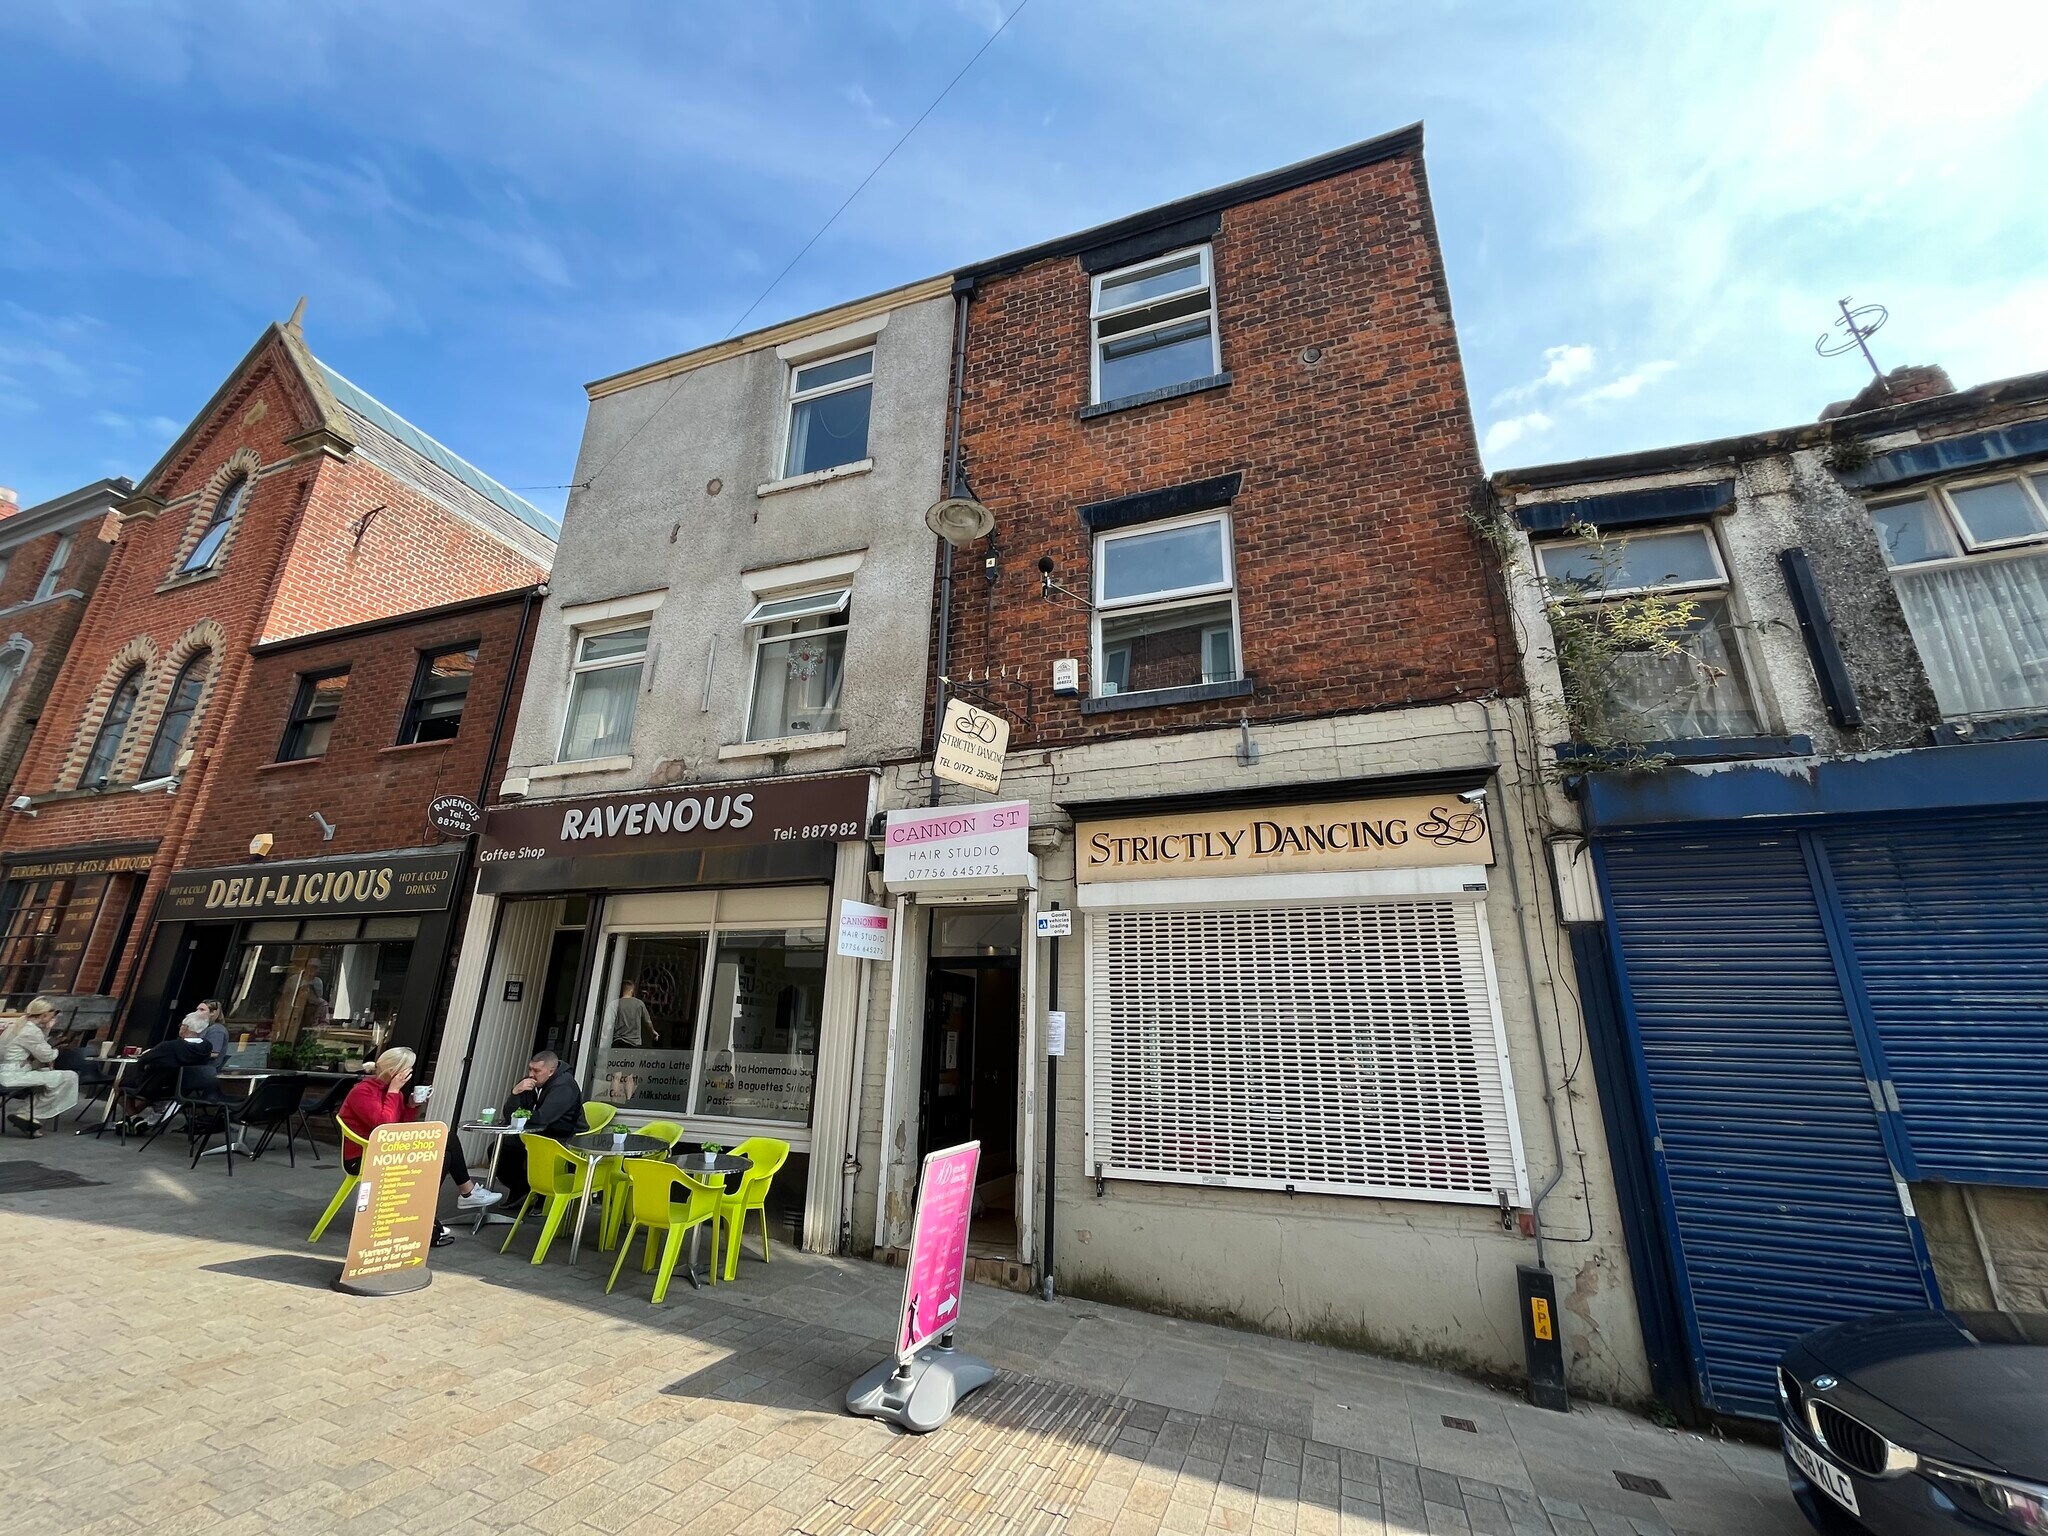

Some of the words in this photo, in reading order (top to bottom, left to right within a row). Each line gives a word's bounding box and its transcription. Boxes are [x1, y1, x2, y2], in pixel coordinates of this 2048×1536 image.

[940, 732, 976, 754] STRICTLY
[976, 745, 1005, 764] DANCING
[433, 798, 480, 821] RAVENOUS
[449, 809, 464, 819] Tel:
[560, 793, 755, 841] RAVENOUS
[437, 816, 471, 830] 887982
[892, 818, 976, 843] CANNON
[992, 810, 1020, 828] ST
[773, 826, 797, 841] Tel:
[801, 822, 858, 839] 887982
[1089, 829, 1246, 866] STRICTLY
[1252, 820, 1408, 858] DANCING
[480, 847, 516, 863] Coffee
[518, 845, 546, 860] Shop
[908, 849, 941, 861] HAIR
[947, 845, 1000, 859] STUDIO
[10, 864, 53, 878] EUROPEAN
[53, 862, 76, 875] FINE
[75, 860, 98, 873] ARTS
[98, 861, 106, 872] &
[106, 856, 153, 871] ANTIQUES
[908, 867, 946, 880] 07756
[952, 864, 999, 877] 645275
[399, 872, 418, 882] HOT
[417, 872, 424, 882] &
[424, 870, 449, 881] COLD
[205, 868, 393, 909] DELI-LICIOUS
[405, 884, 437, 895] DRINKS
[175, 897, 195, 906] FOOD
[841, 916, 873, 927] CANNON
[841, 930, 859, 939] HAIR
[860, 932, 885, 943] STUDIO
[840, 942, 860, 951] 07756
[862, 946, 884, 955] 645275
[638, 1060, 666, 1069] Mocha
[669, 1060, 691, 1070] Latte
[738, 1080, 784, 1093] Baguettes
[638, 1091, 681, 1101] Milkshakes
[376, 1129, 442, 1143] Ravenous
[380, 1141, 411, 1152] Coffee
[412, 1140, 435, 1151] Shop
[372, 1153, 406, 1167] NOW
[406, 1150, 439, 1164] OPEN
[358, 1246, 393, 1259] Yummy
[393, 1241, 422, 1252] Treats
[357, 1265, 383, 1276] Cannon
[1814, 1456, 1854, 1506] KLC
